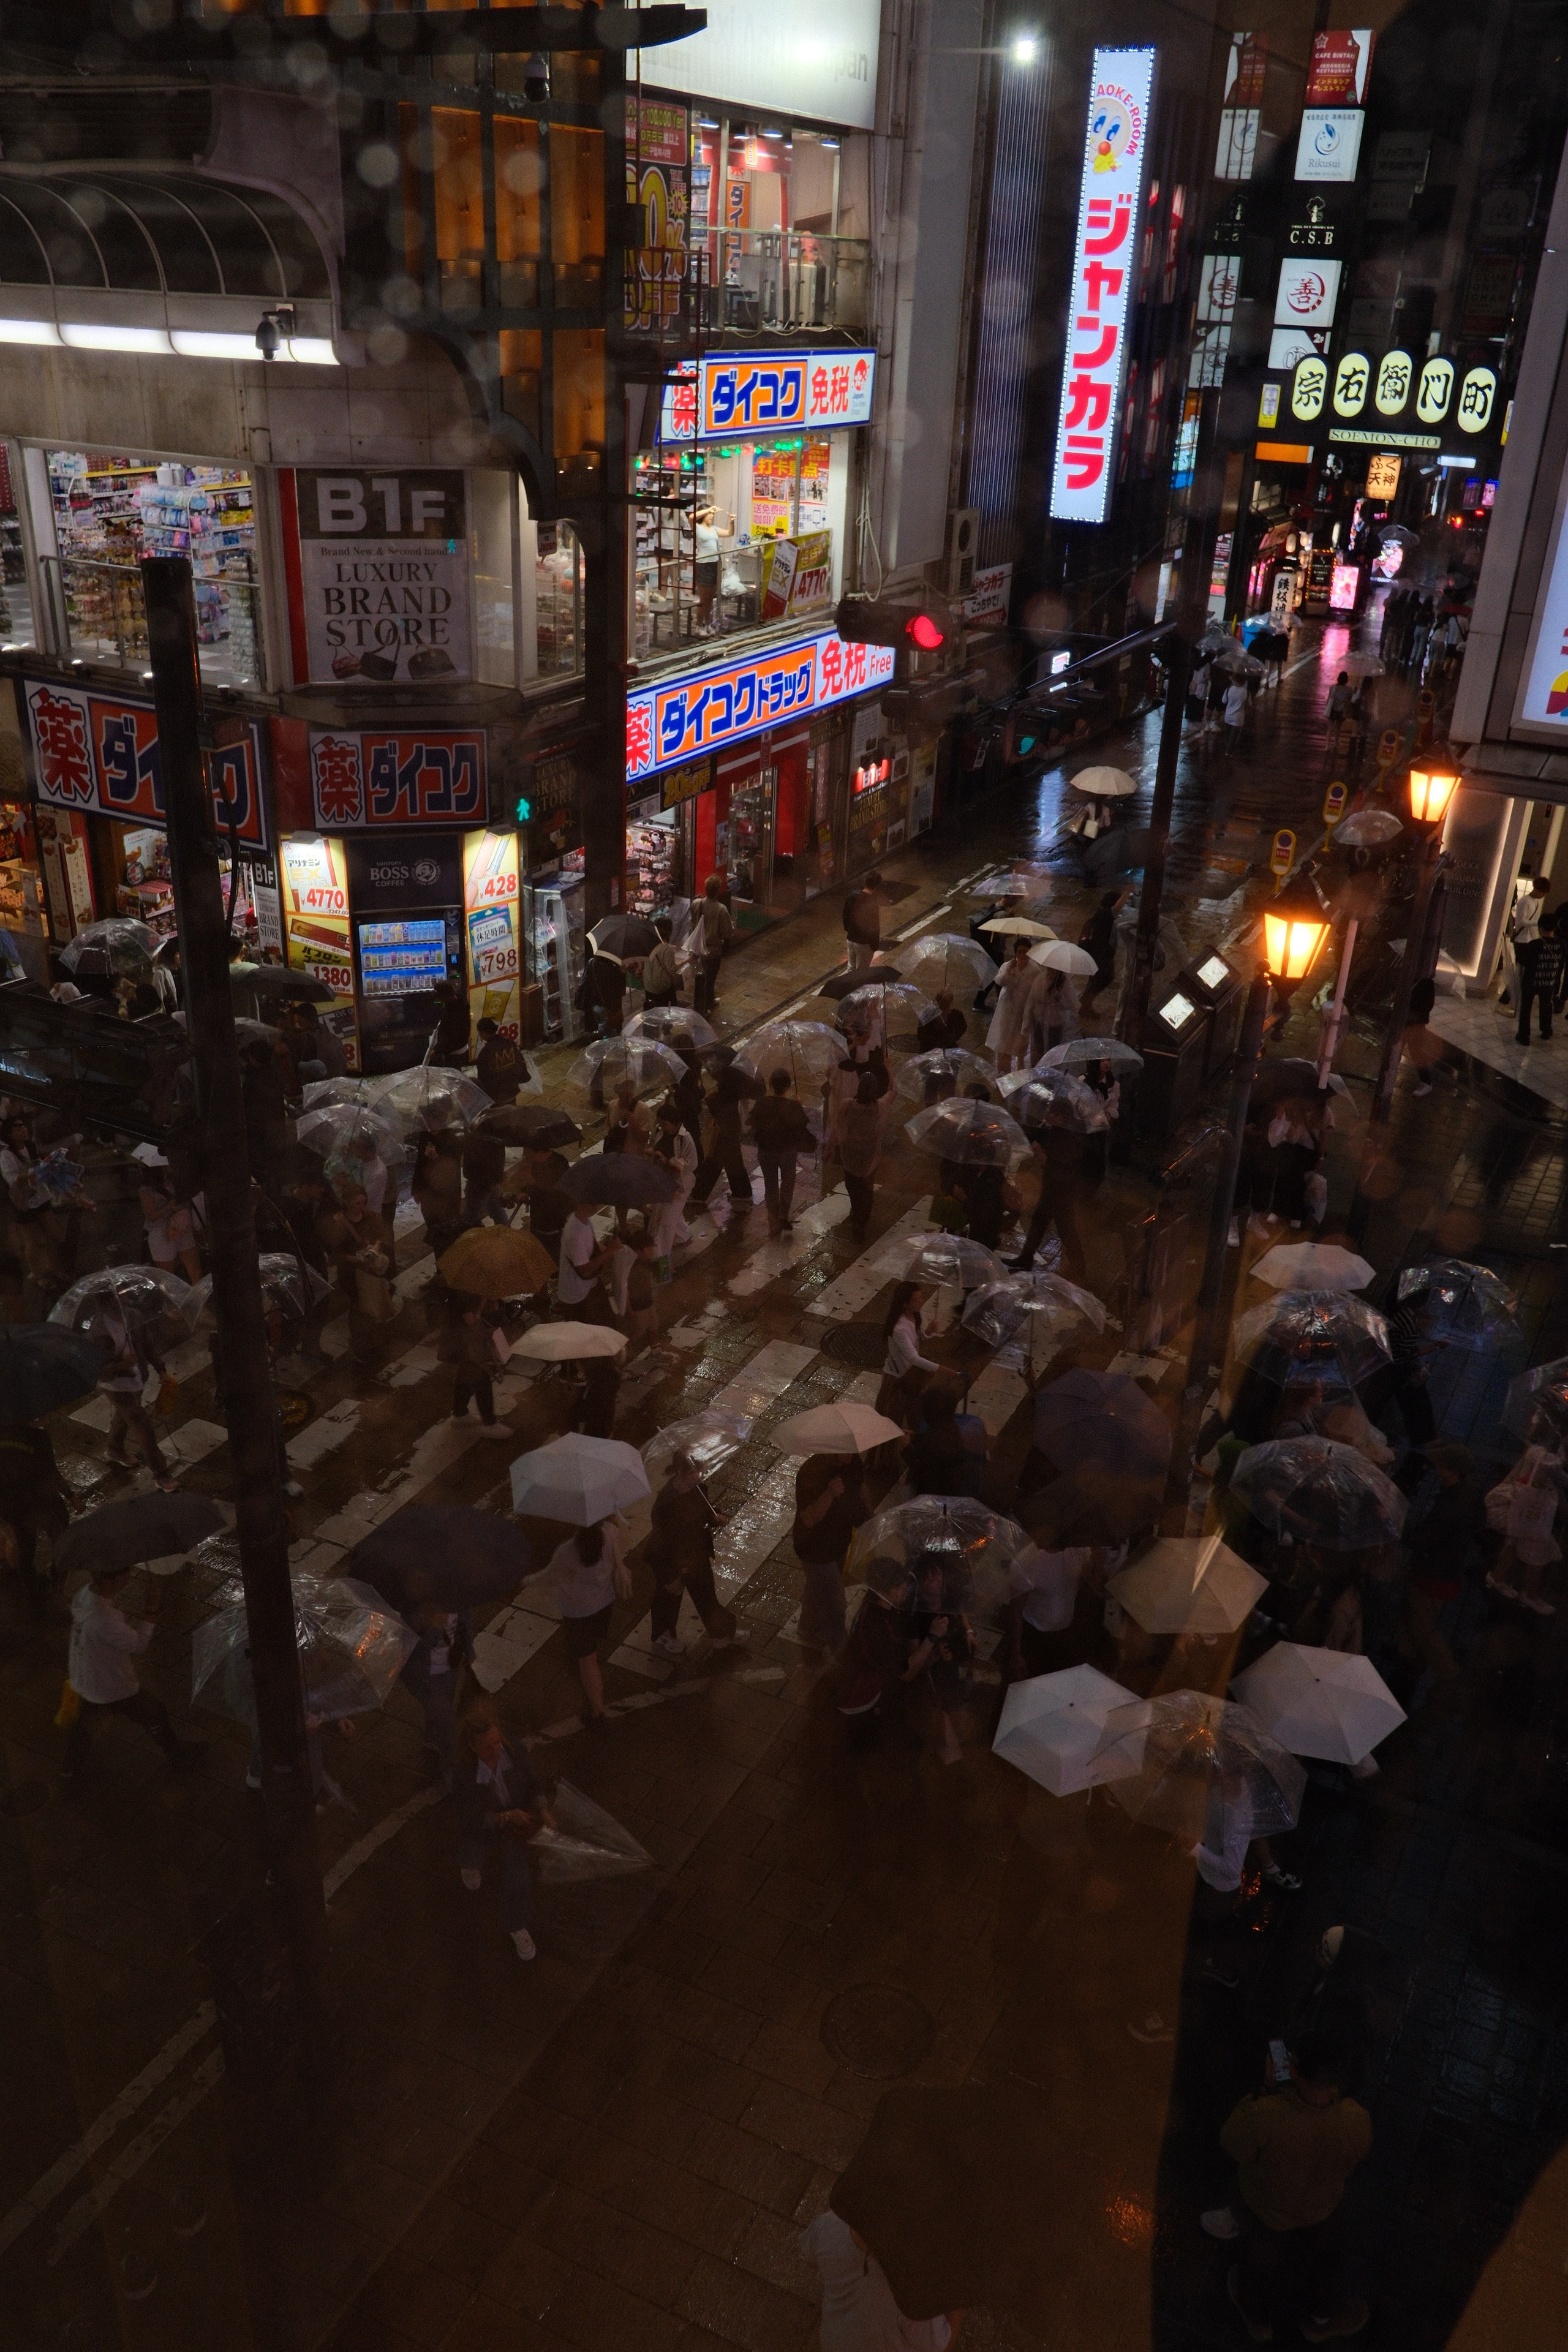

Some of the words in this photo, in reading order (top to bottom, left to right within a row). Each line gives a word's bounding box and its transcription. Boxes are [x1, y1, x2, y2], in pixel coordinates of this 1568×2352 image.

[1308, 159, 1341, 168] Rikusui
[1290, 277, 1319, 304] 善
[1064, 192, 1133, 489] ジャンカラ
[710, 368, 803, 425] ダイコク
[810, 366, 850, 417] 免税
[1330, 430, 1439, 448] SOEMON-CHO
[316, 478, 446, 532] B1F
[753, 502, 788, 516] 送免费的
[320, 546, 350, 556] Brand
[353, 546, 373, 556] New
[376, 546, 385, 556] &
[388, 546, 421, 557] Second
[424, 546, 448, 556] hand
[336, 562, 438, 582] LUXURY
[322, 586, 452, 616] BRAND
[326, 618, 450, 647] STORE
[870, 655, 891, 677] Free
[662, 661, 813, 755] ダイコクドラッグ
[820, 639, 867, 701] 免税
[36, 699, 89, 796] 薬
[101, 713, 250, 826] ダイク
[317, 740, 361, 819] 薬
[370, 741, 478, 816] ダイコク
[254, 862, 274, 884] B1F
[287, 859, 320, 867] アリナミン
[369, 866, 409, 881] BOSS
[290, 867, 322, 881] EX
[259, 913, 279, 927] BRAND
[260, 925, 279, 940] STORE
[477, 924, 506, 943] 休足時間
